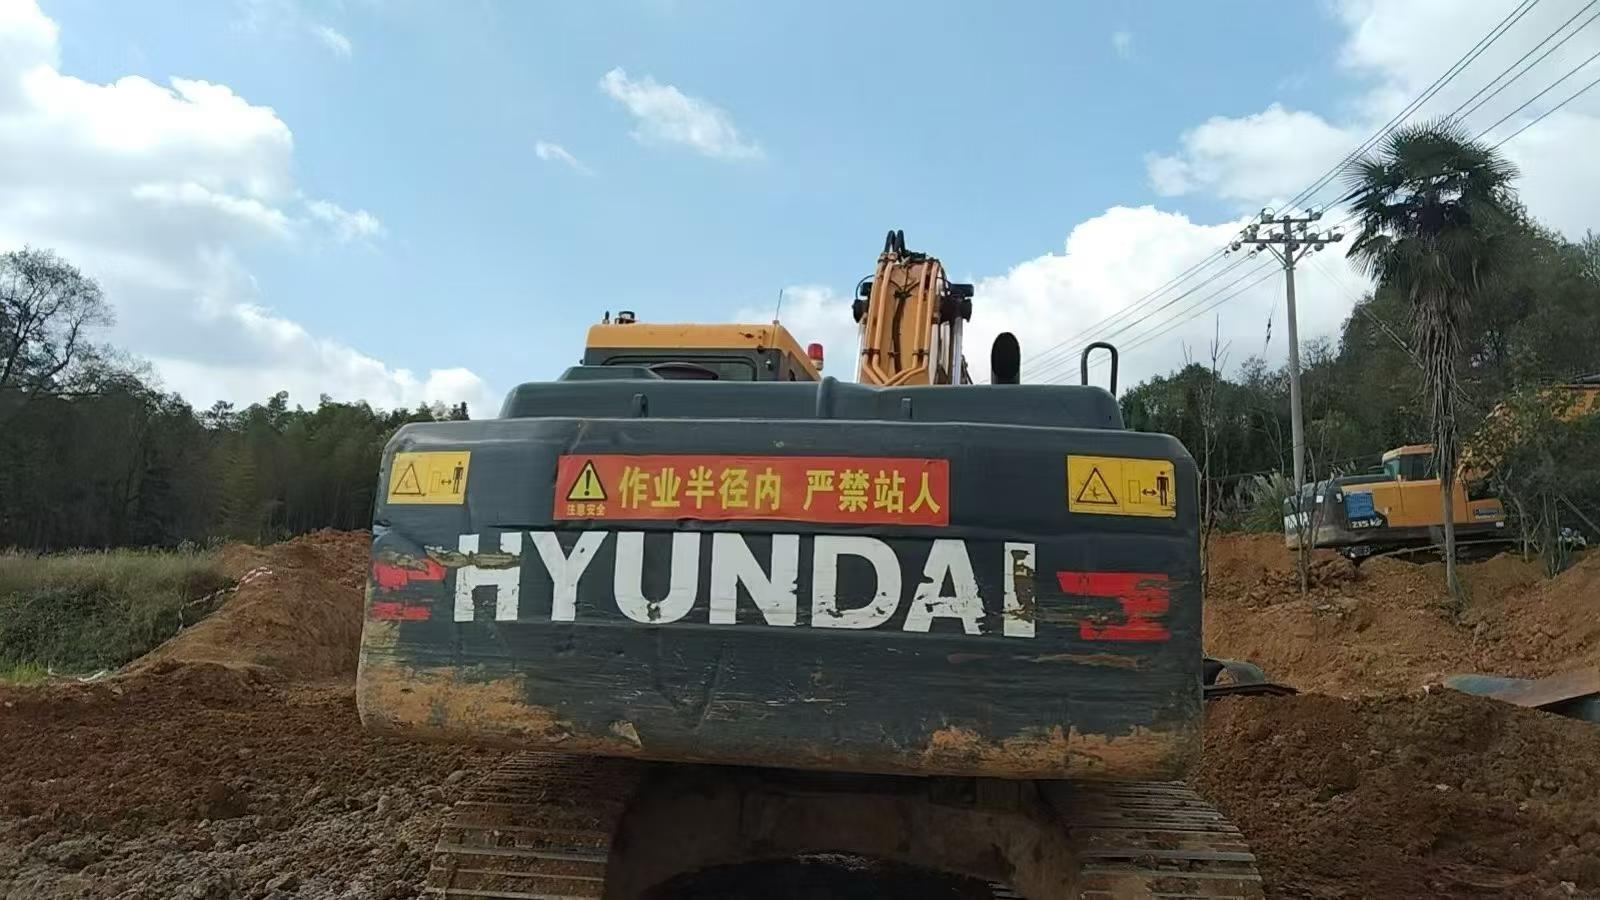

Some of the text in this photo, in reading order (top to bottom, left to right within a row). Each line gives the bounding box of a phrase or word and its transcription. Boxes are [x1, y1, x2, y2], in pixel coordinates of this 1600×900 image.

[619, 465, 941, 513] 作业半径内 严禁站人
[453, 530, 1037, 638] HYUNDAI
